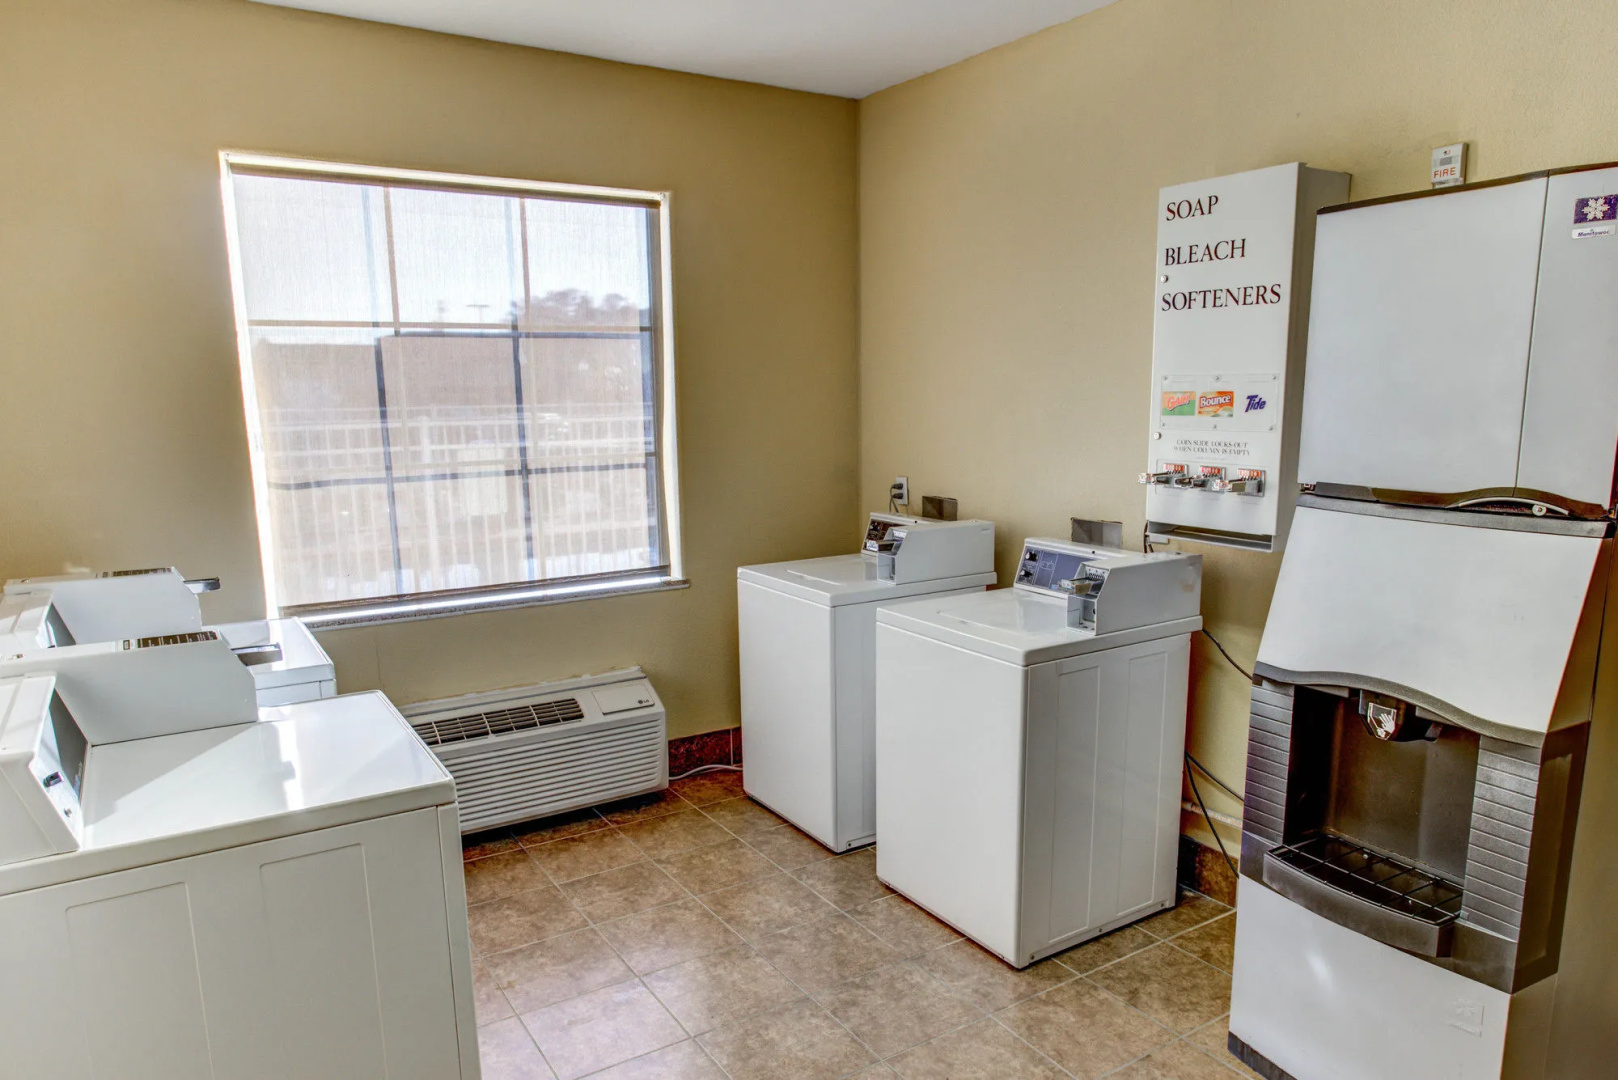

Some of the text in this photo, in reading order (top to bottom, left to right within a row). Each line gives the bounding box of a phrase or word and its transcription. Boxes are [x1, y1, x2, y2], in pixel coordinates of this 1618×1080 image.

[1433, 166, 1456, 179] FIRE
[1166, 194, 1219, 222] SOAP
[1164, 237, 1247, 266] BLEACH
[1161, 283, 1282, 312] SOFTENERS
[1199, 394, 1231, 408] Bounce
[1244, 394, 1267, 413] Tide
[1193, 446, 1220, 454] COLUMN
